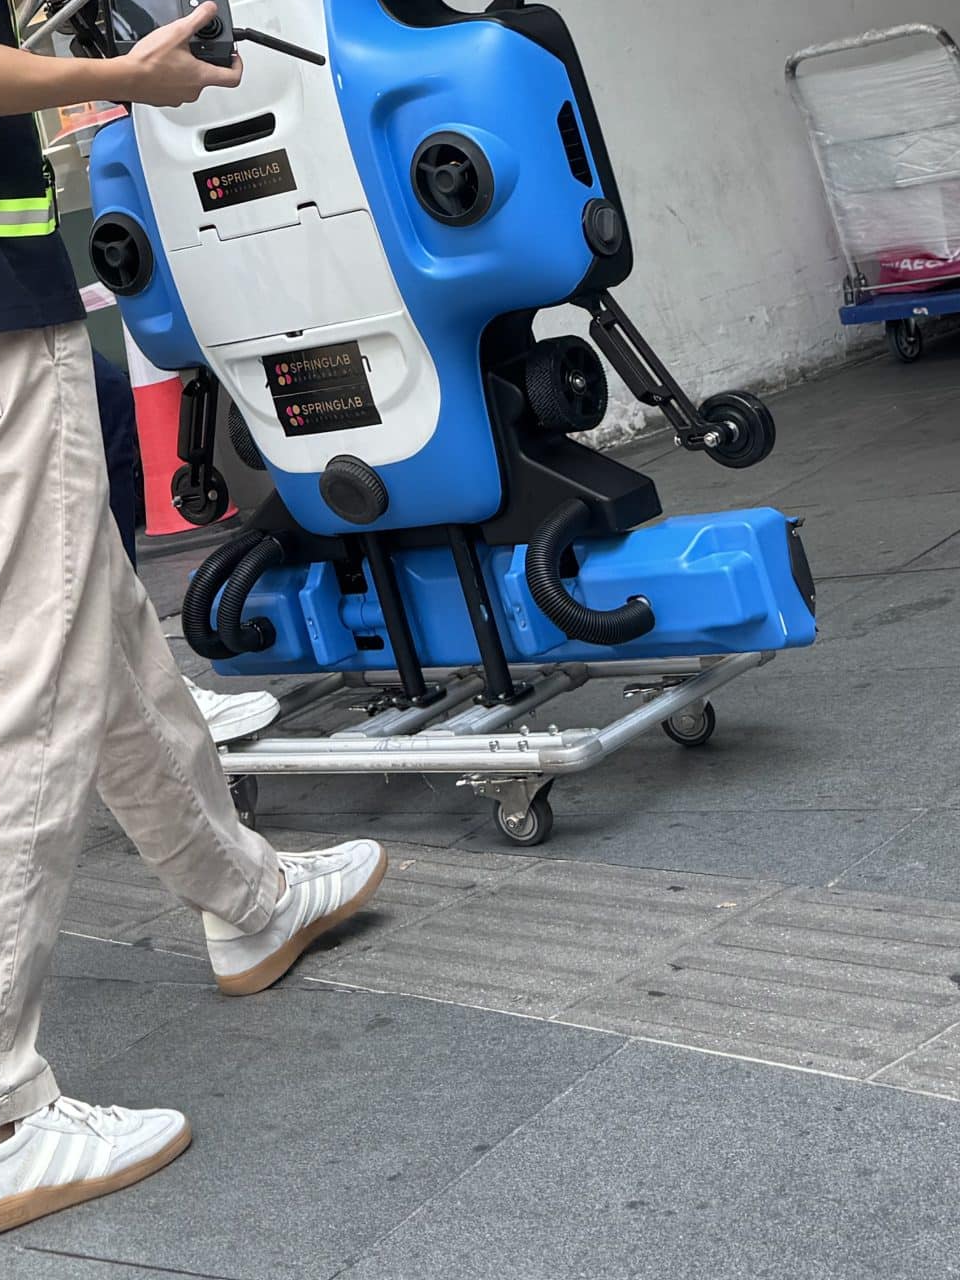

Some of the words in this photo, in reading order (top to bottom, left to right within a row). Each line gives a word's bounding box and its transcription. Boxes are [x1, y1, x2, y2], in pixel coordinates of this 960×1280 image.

[220, 162, 281, 186] SPRINGLAB
[290, 353, 351, 374] SPRINGLAB
[301, 396, 363, 415] SPRINGLAB
